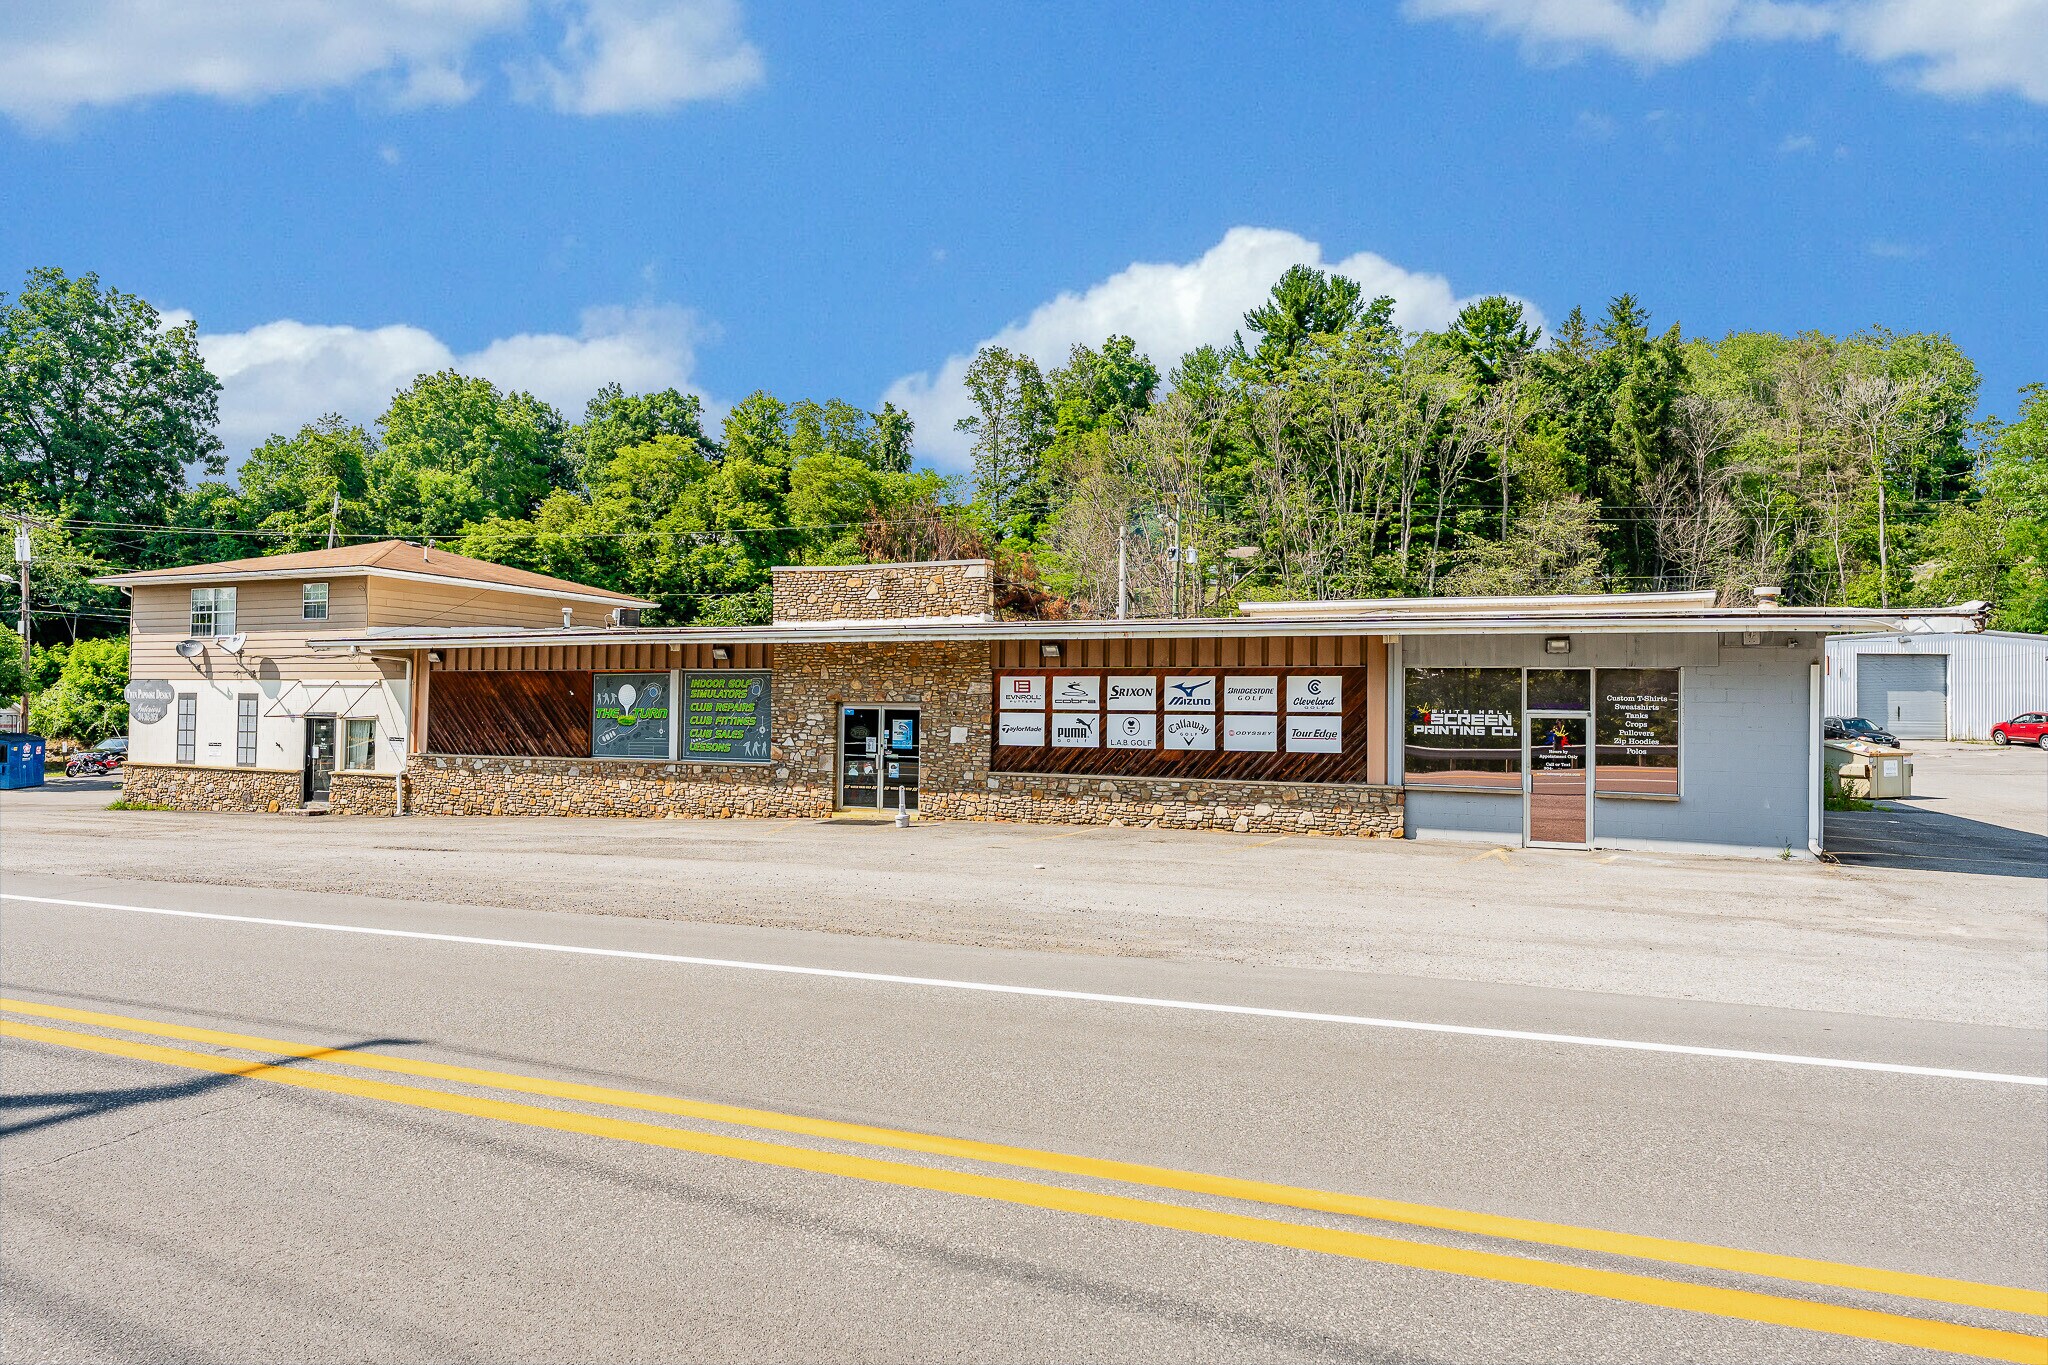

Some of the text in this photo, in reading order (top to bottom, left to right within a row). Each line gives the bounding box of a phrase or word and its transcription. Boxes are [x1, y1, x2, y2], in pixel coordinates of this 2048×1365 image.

[690, 679, 752, 688] INDOOR GOLF
[690, 689, 748, 698] SIMULATORS
[1168, 696, 1211, 705] MIZUNO
[1293, 697, 1335, 706] Cleveland
[690, 703, 755, 711] CLUB REPAIRS
[595, 707, 668, 719] THE TURN
[690, 716, 757, 725] CLUB FITTINGS
[1430, 713, 1512, 726] SCREEN
[1001, 724, 1042, 733] TaylorMade
[1168, 718, 1210, 735] Callaway
[1625, 721, 1648, 729] Crops
[689, 729, 744, 738] CLUB SALES
[1057, 728, 1087, 738] PUMA
[1291, 729, 1338, 740] Tour Edge
[1413, 725, 1518, 737] PRINTING CO.
[1618, 729, 1655, 737] Pullovers
[1130, 739, 1152, 747] GOLF
[1613, 738, 1627, 746] Zip
[689, 742, 731, 752] LESSONS
